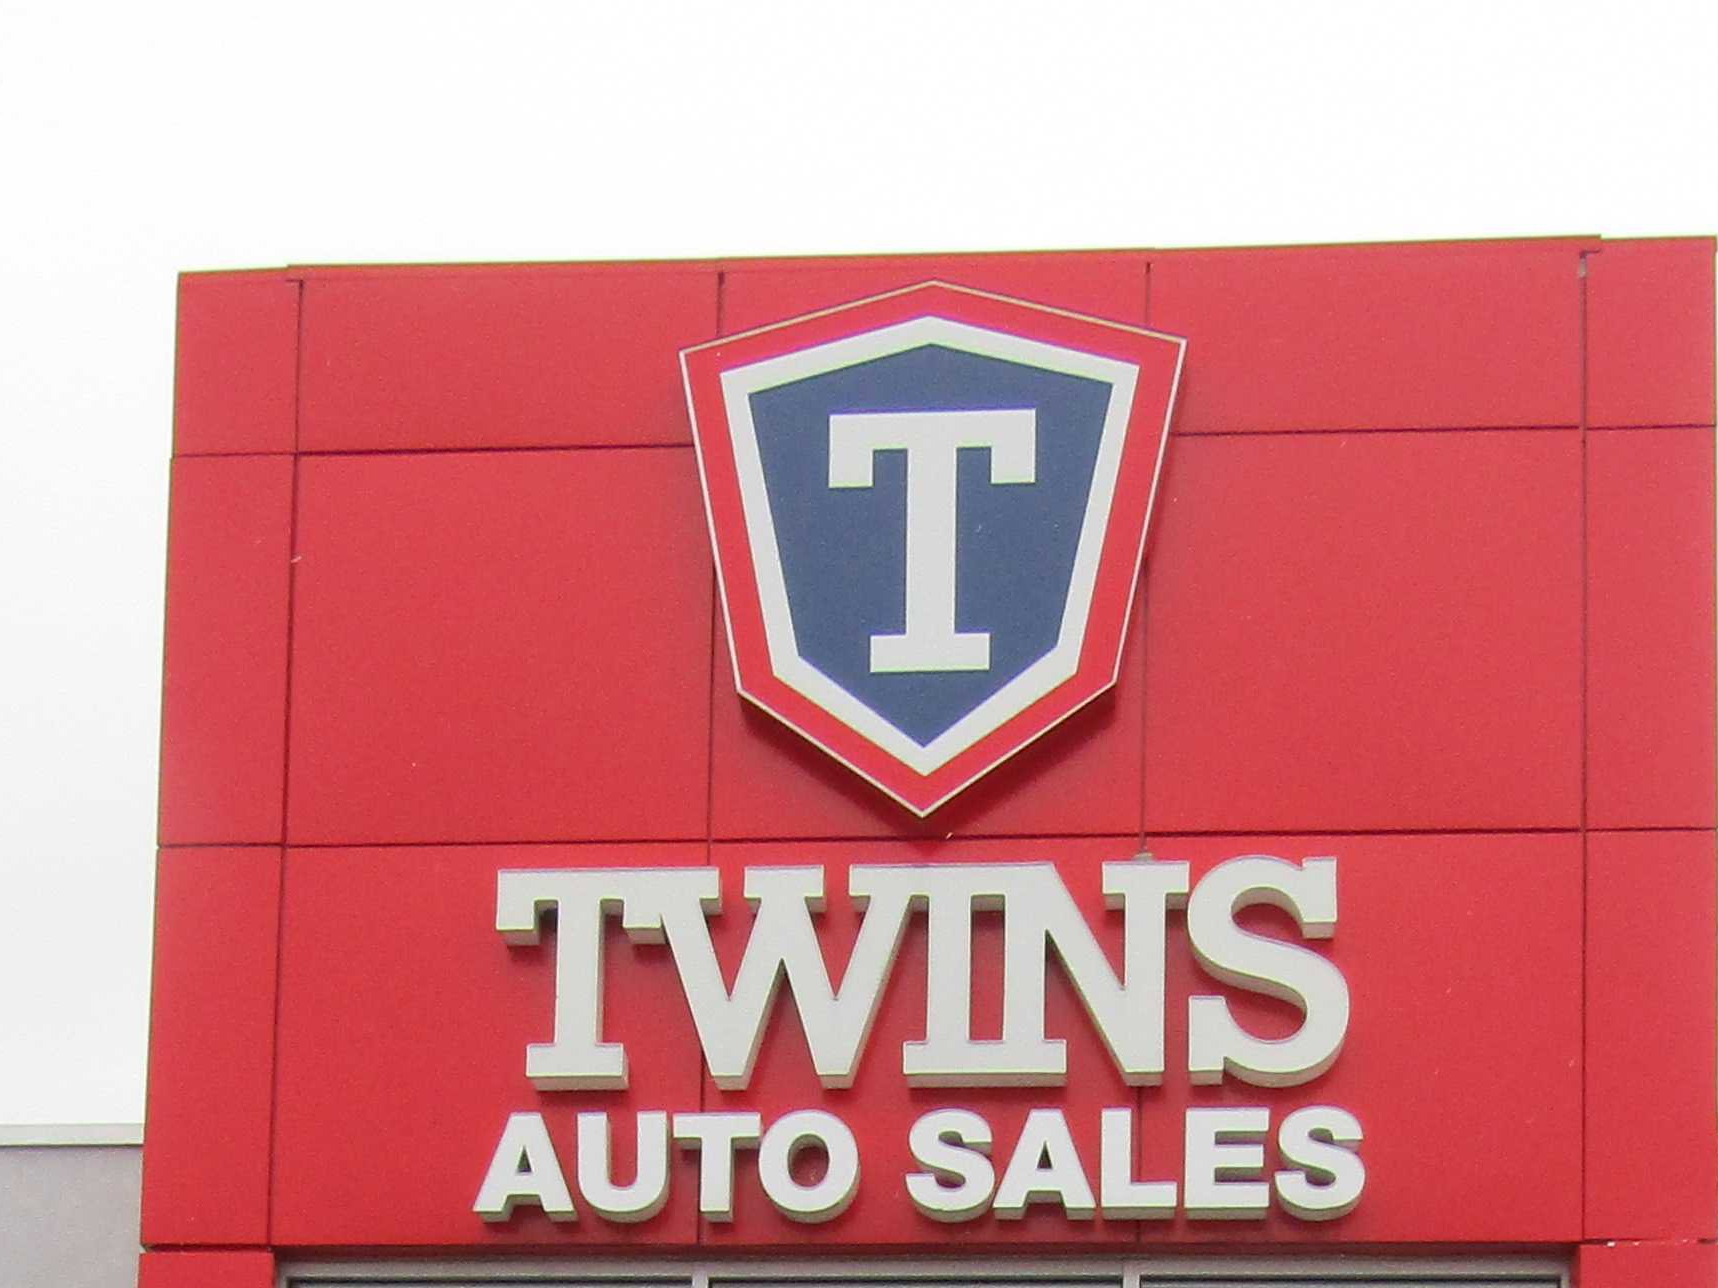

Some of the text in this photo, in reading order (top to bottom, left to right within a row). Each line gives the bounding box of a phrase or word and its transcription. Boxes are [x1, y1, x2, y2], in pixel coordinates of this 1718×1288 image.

[828, 408, 1036, 672] T
[495, 854, 1350, 1089] TWINS
[472, 1105, 1367, 1222] AUTO SALES
